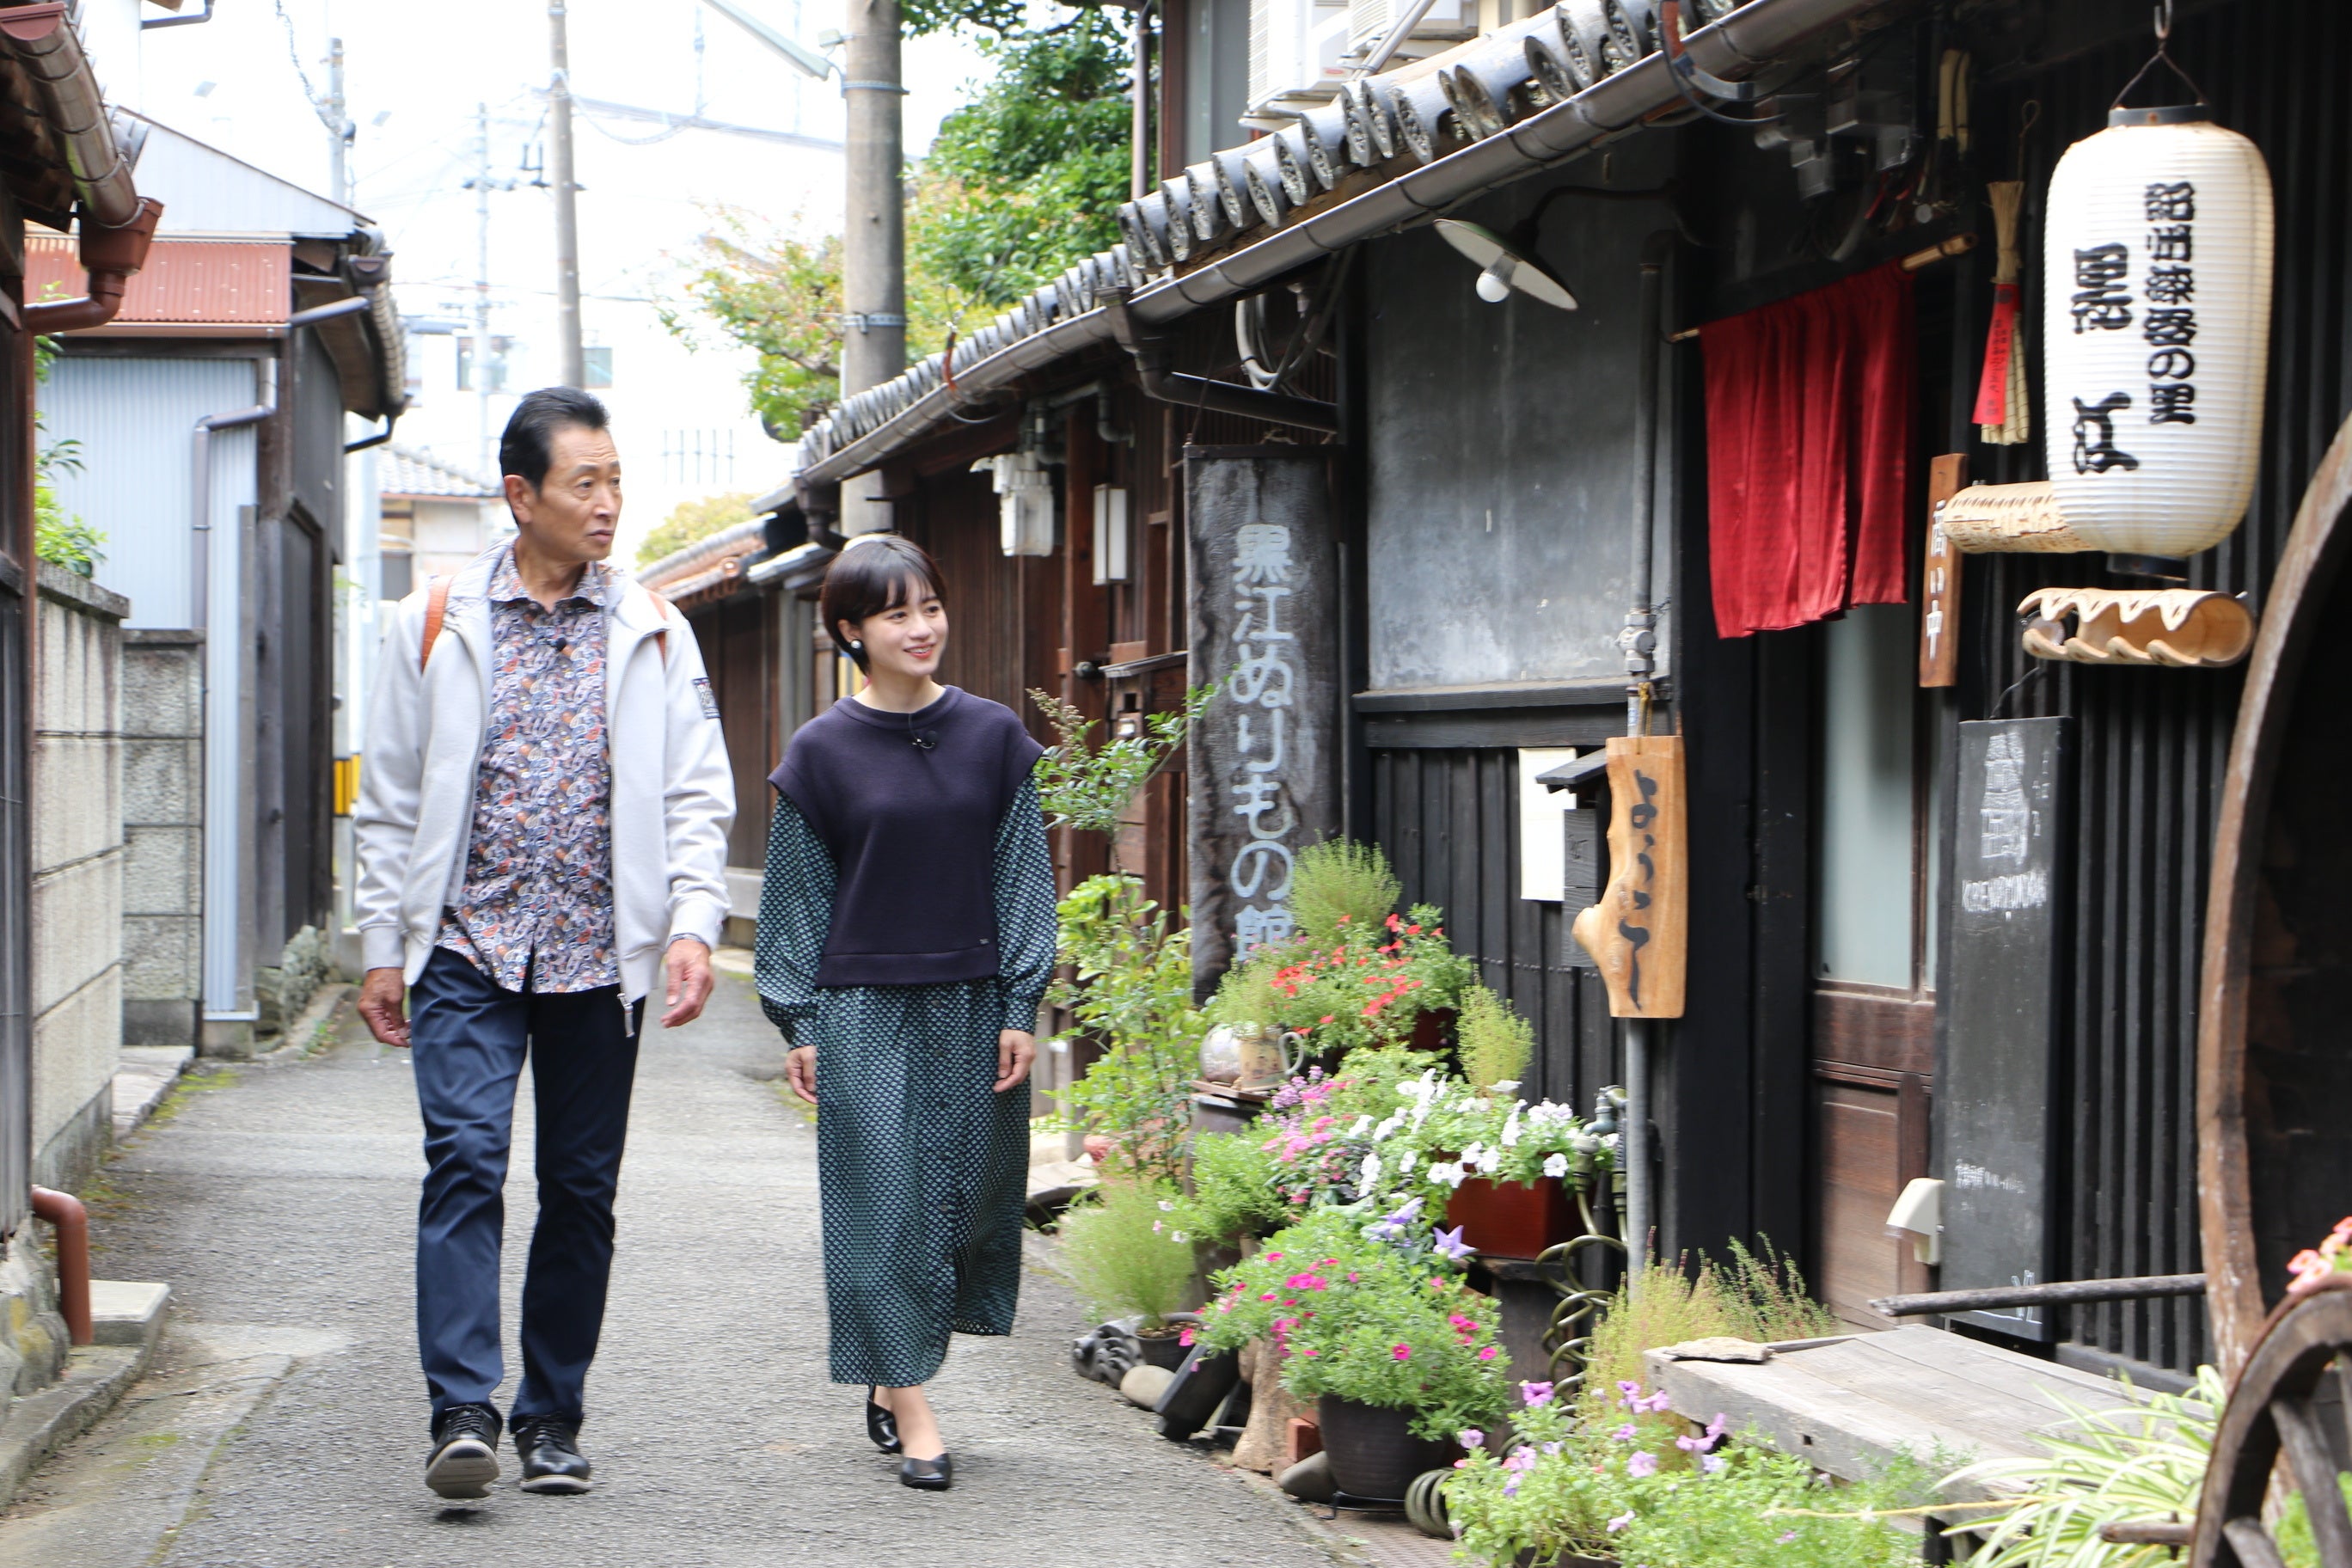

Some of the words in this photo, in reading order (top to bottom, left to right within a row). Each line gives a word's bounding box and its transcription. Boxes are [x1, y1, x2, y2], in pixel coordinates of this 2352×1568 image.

[1231, 524, 1293, 962] 黒江ぬりもの館
